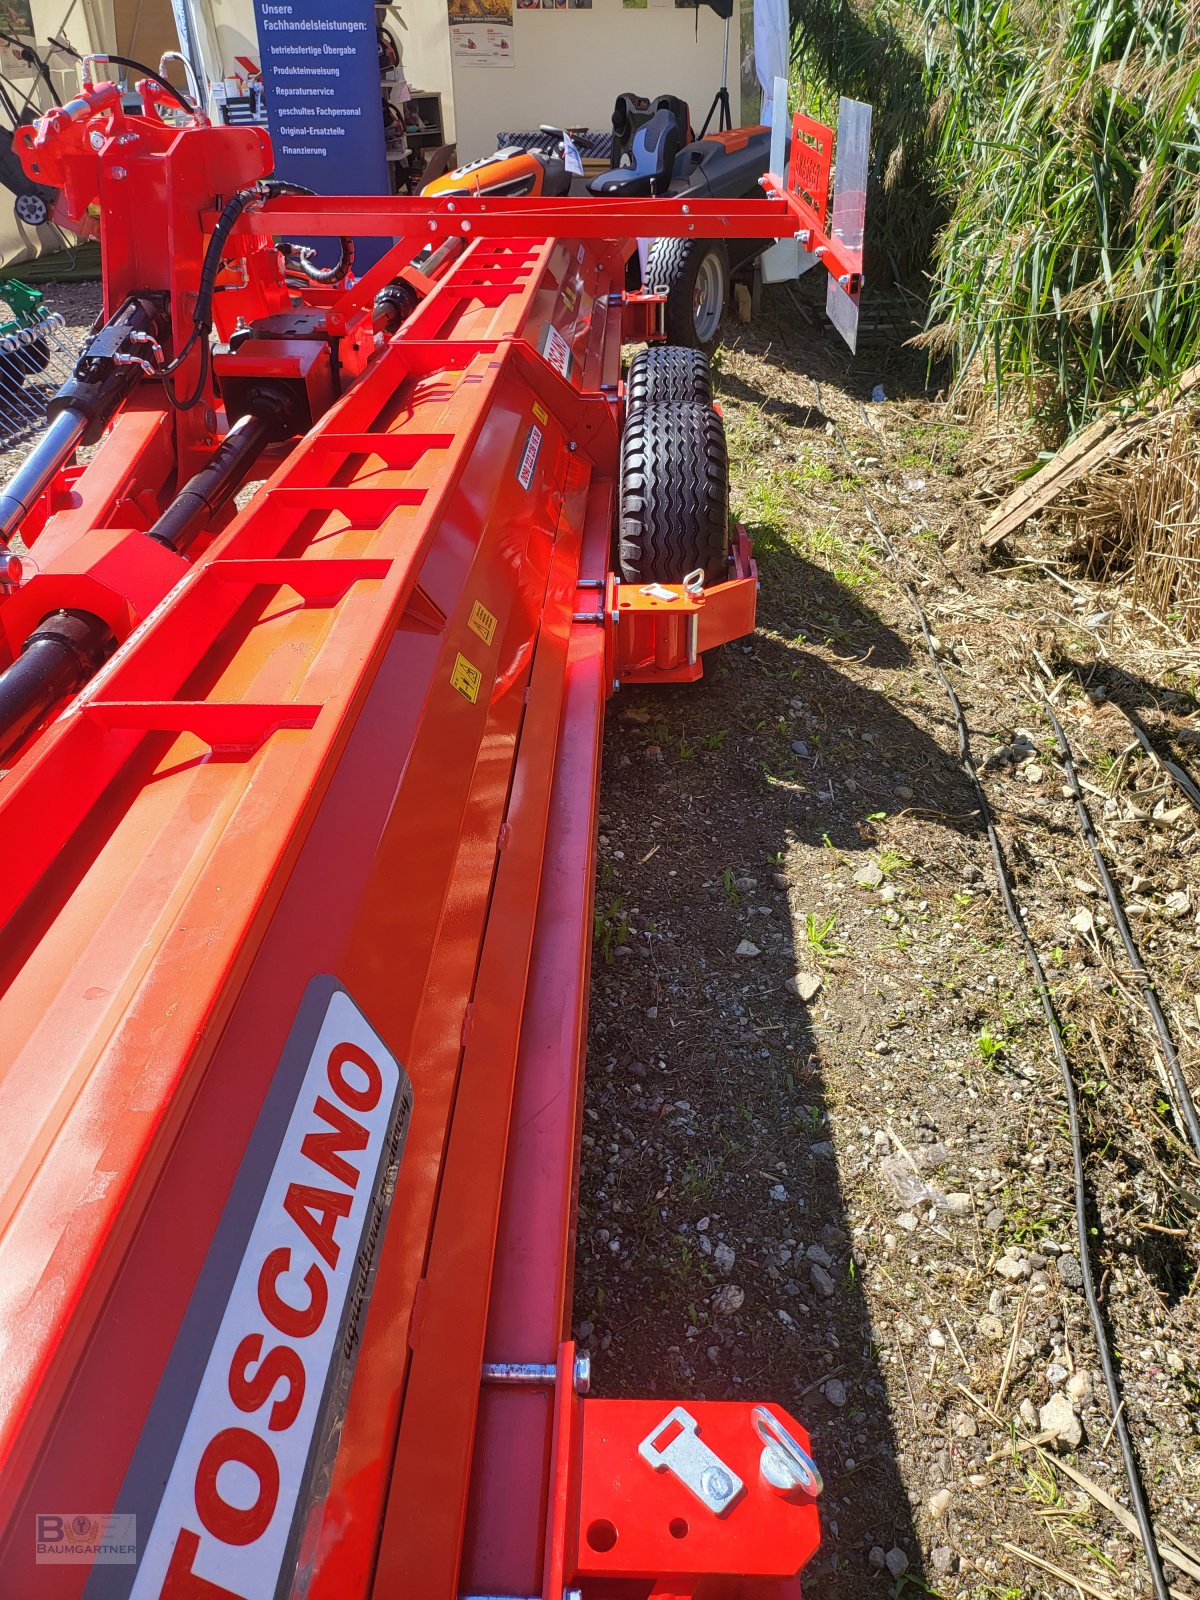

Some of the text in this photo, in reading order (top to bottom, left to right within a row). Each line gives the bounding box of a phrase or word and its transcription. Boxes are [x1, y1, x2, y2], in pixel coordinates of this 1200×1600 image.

[261, 3, 293, 14] Unsere
[263, 19, 368, 33] Fachhandelsleistungen:
[270, 43, 357, 56] betriebsfertige Übergabe
[273, 66, 340, 77] Produkteinweisung
[275, 86, 335, 97] Reparaturservice
[278, 106, 361, 117] geschultes Fachpersonal
[280, 126, 345, 136] Original-Ersatzteile
[282, 145, 327, 156] Finanzierung
[344, 1094, 410, 1359] agricultural mchinery
